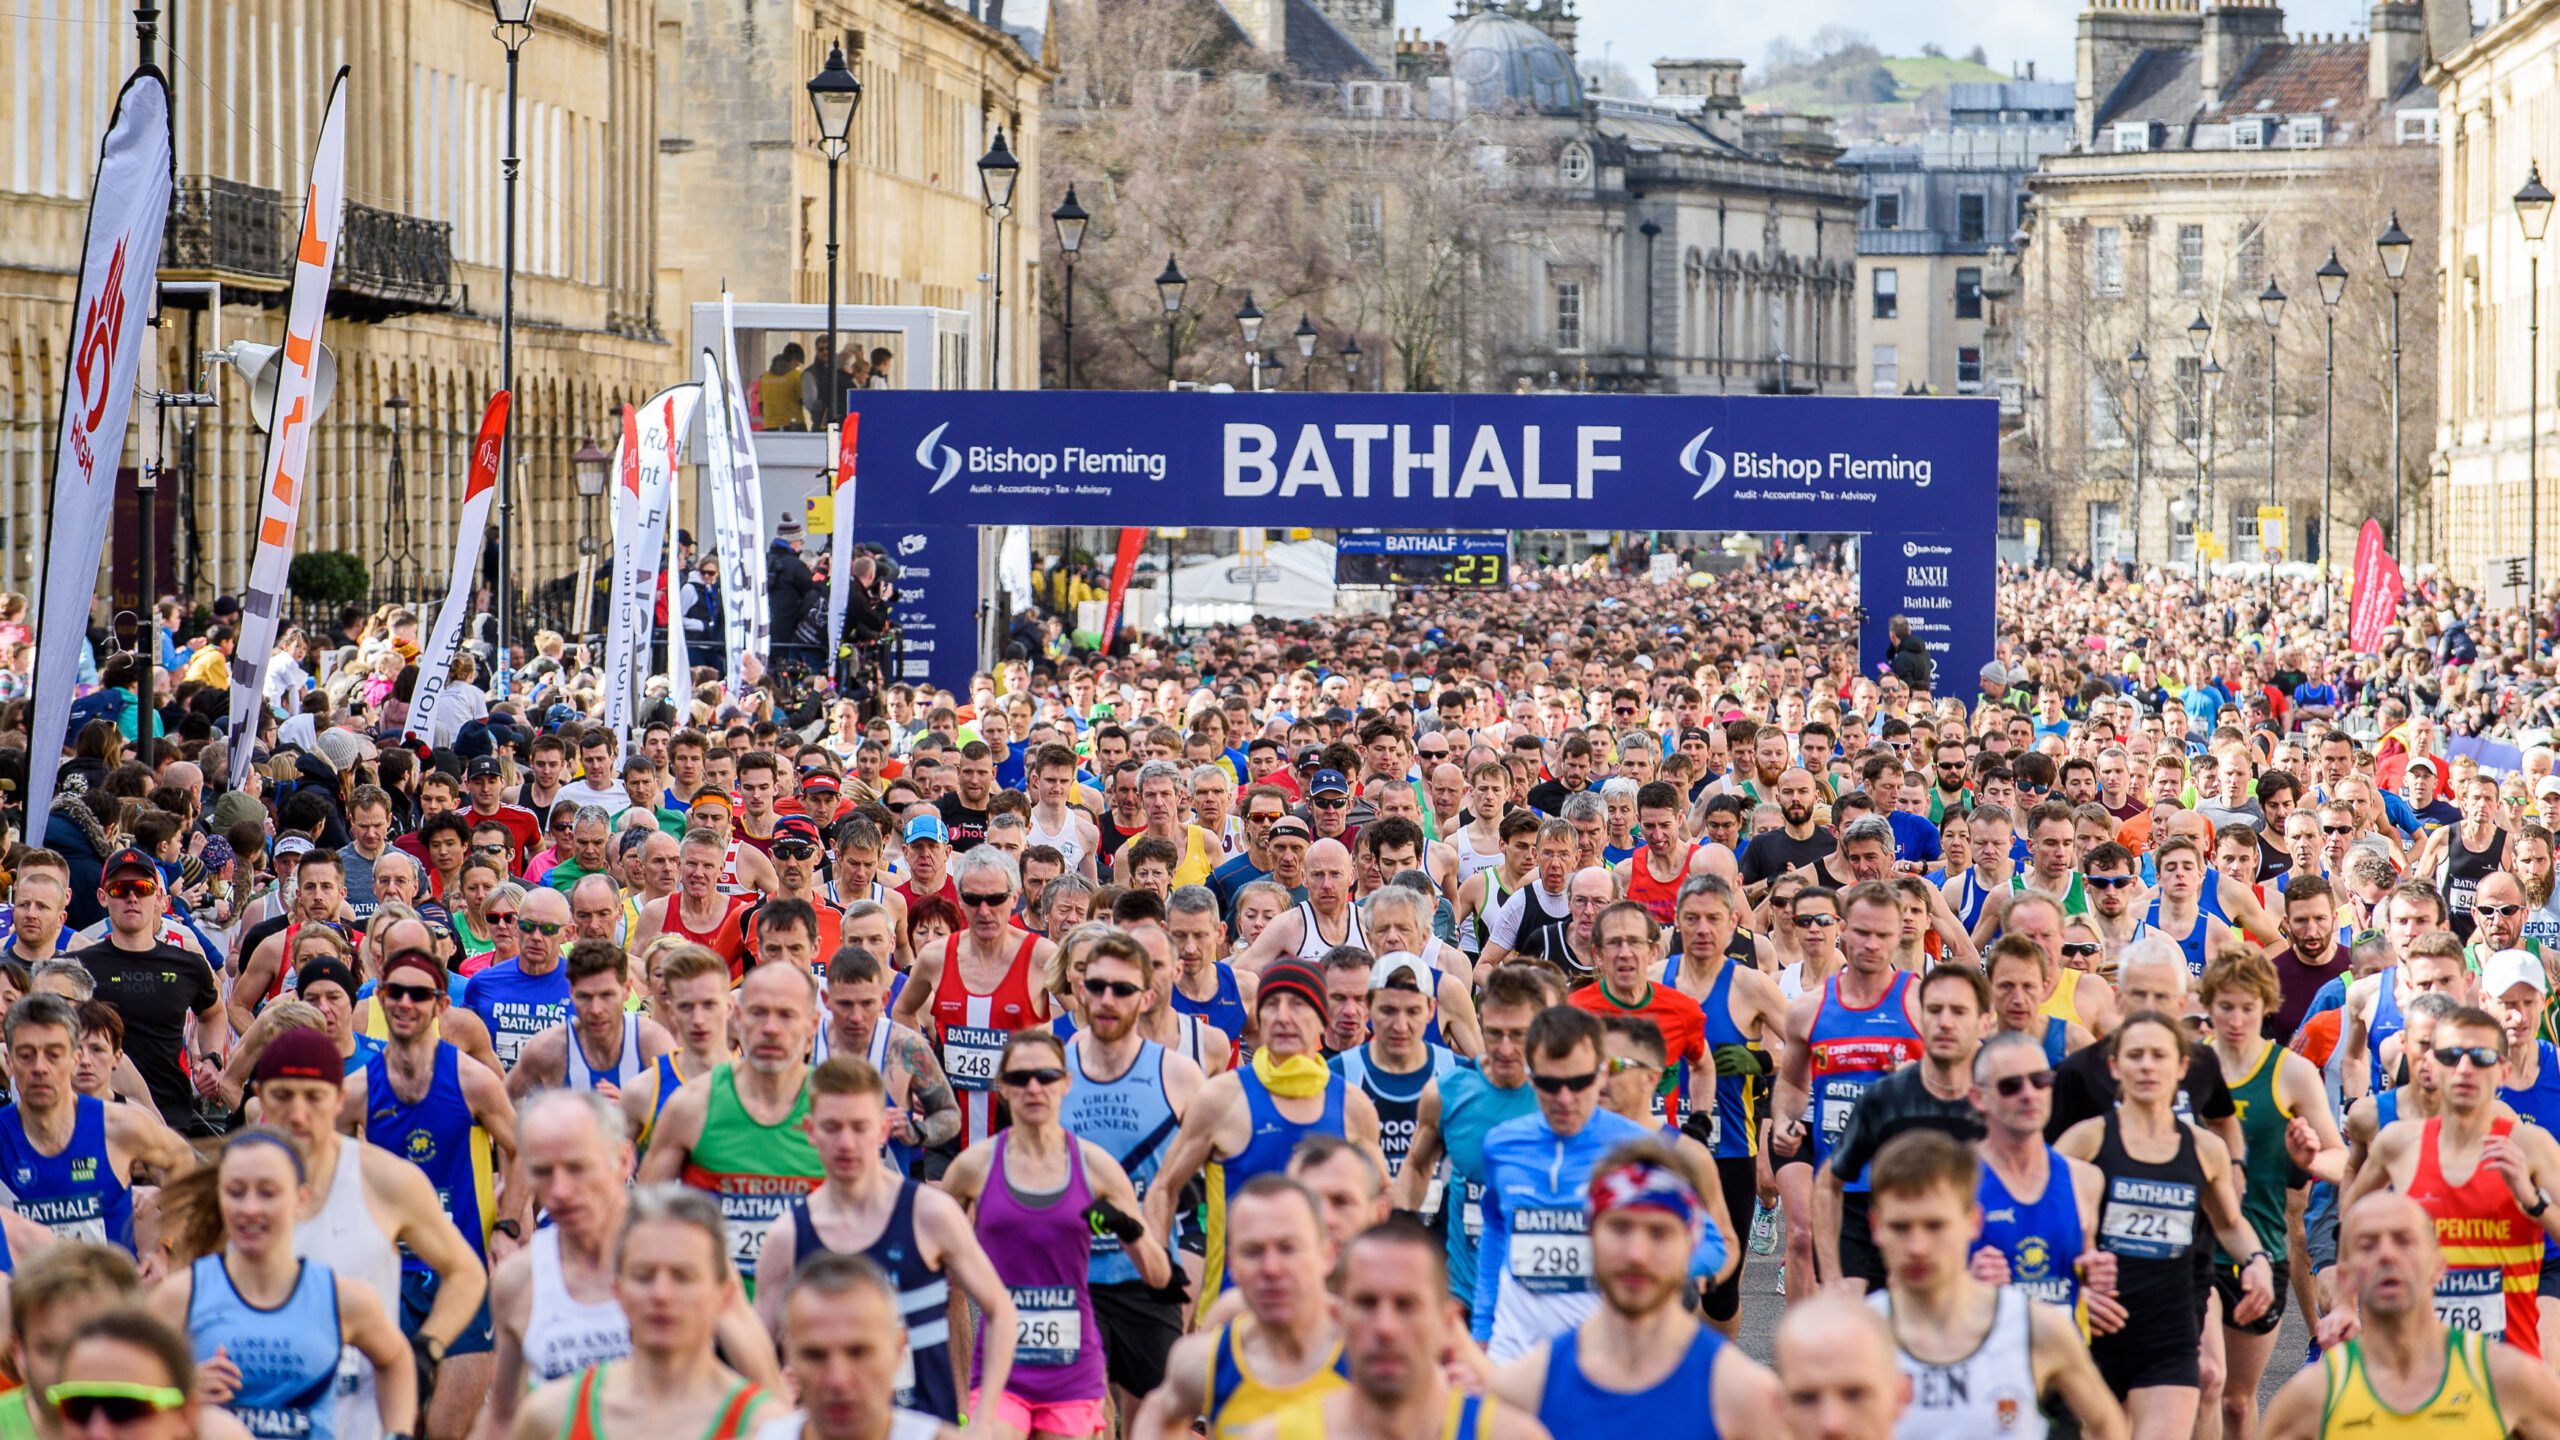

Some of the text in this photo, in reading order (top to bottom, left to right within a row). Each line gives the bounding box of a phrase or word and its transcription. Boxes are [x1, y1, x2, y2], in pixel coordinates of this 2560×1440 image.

[70, 411, 95, 486] HIGH
[968, 446, 1167, 481] Bishop Fleming
[1223, 422, 1623, 500] BATHALF
[1733, 451, 1933, 487] Bishop Fleming
[1763, 490, 1816, 501] Accountancy
[1820, 490, 1835, 500] Tax
[1840, 490, 1877, 502] Advisory
[1386, 536, 1457, 551] BATHALF
[1907, 566, 1948, 580] BATH
[1903, 595, 1952, 609] Bath Life
[947, 1027, 1008, 1047] BATHALF
[1828, 1042, 1892, 1056] CHEPSTOW
[957, 1054, 991, 1077] 248
[1082, 1093, 1130, 1106] GREAT
[1072, 1105, 1140, 1120] WESTERN
[1073, 1119, 1140, 1134] RUNNERS
[721, 1178, 810, 1195] STROUD
[2113, 1181, 2196, 1207] BATHALF
[17, 1196, 101, 1221] BATHALF
[2125, 1212, 2168, 1238] 224
[1533, 1246, 1579, 1274] 298
[1008, 1288, 1076, 1308] ATHALF
[2435, 1306, 2483, 1332] 768
[1017, 1321, 1060, 1346] 256
